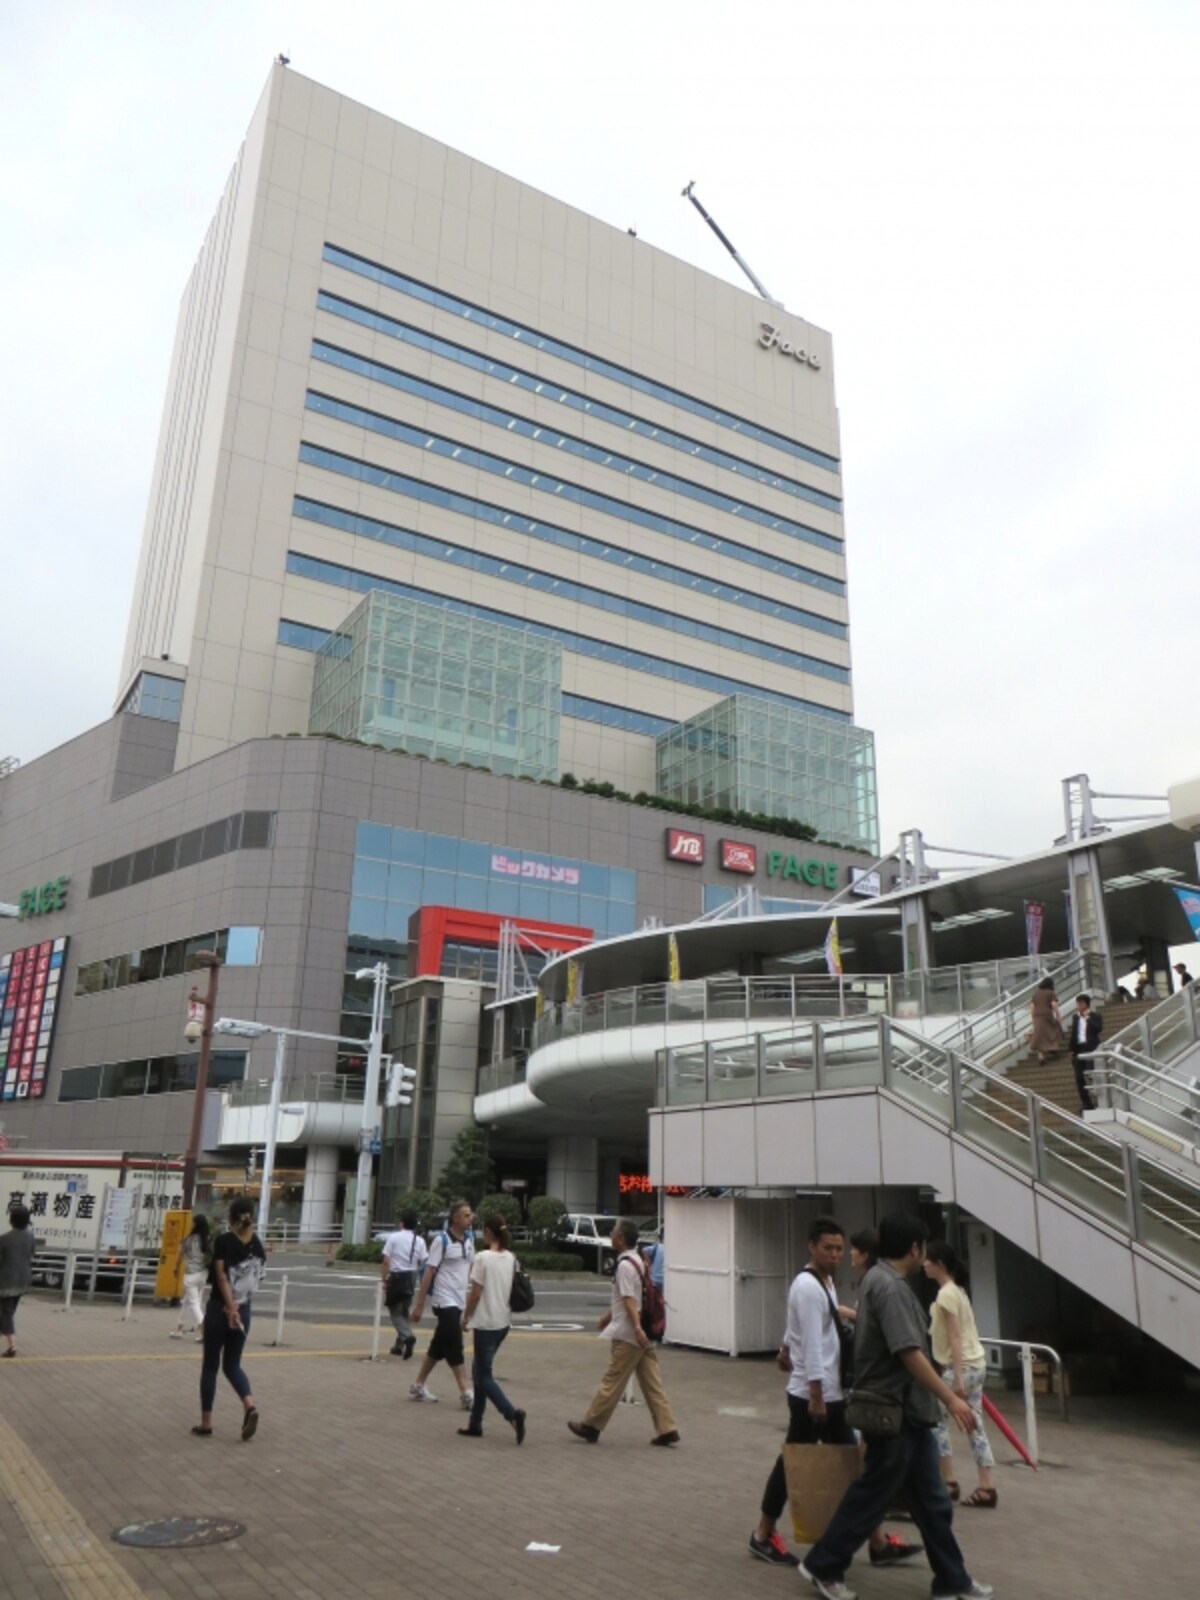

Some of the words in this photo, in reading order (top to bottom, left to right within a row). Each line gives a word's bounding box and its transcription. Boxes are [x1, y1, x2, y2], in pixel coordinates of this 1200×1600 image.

[757, 320, 821, 371] Face
[672, 835, 701, 855] JTB
[491, 854, 580, 885] ビックカメラ
[768, 849, 838, 889] FACE
[19, 874, 71, 919] FACE
